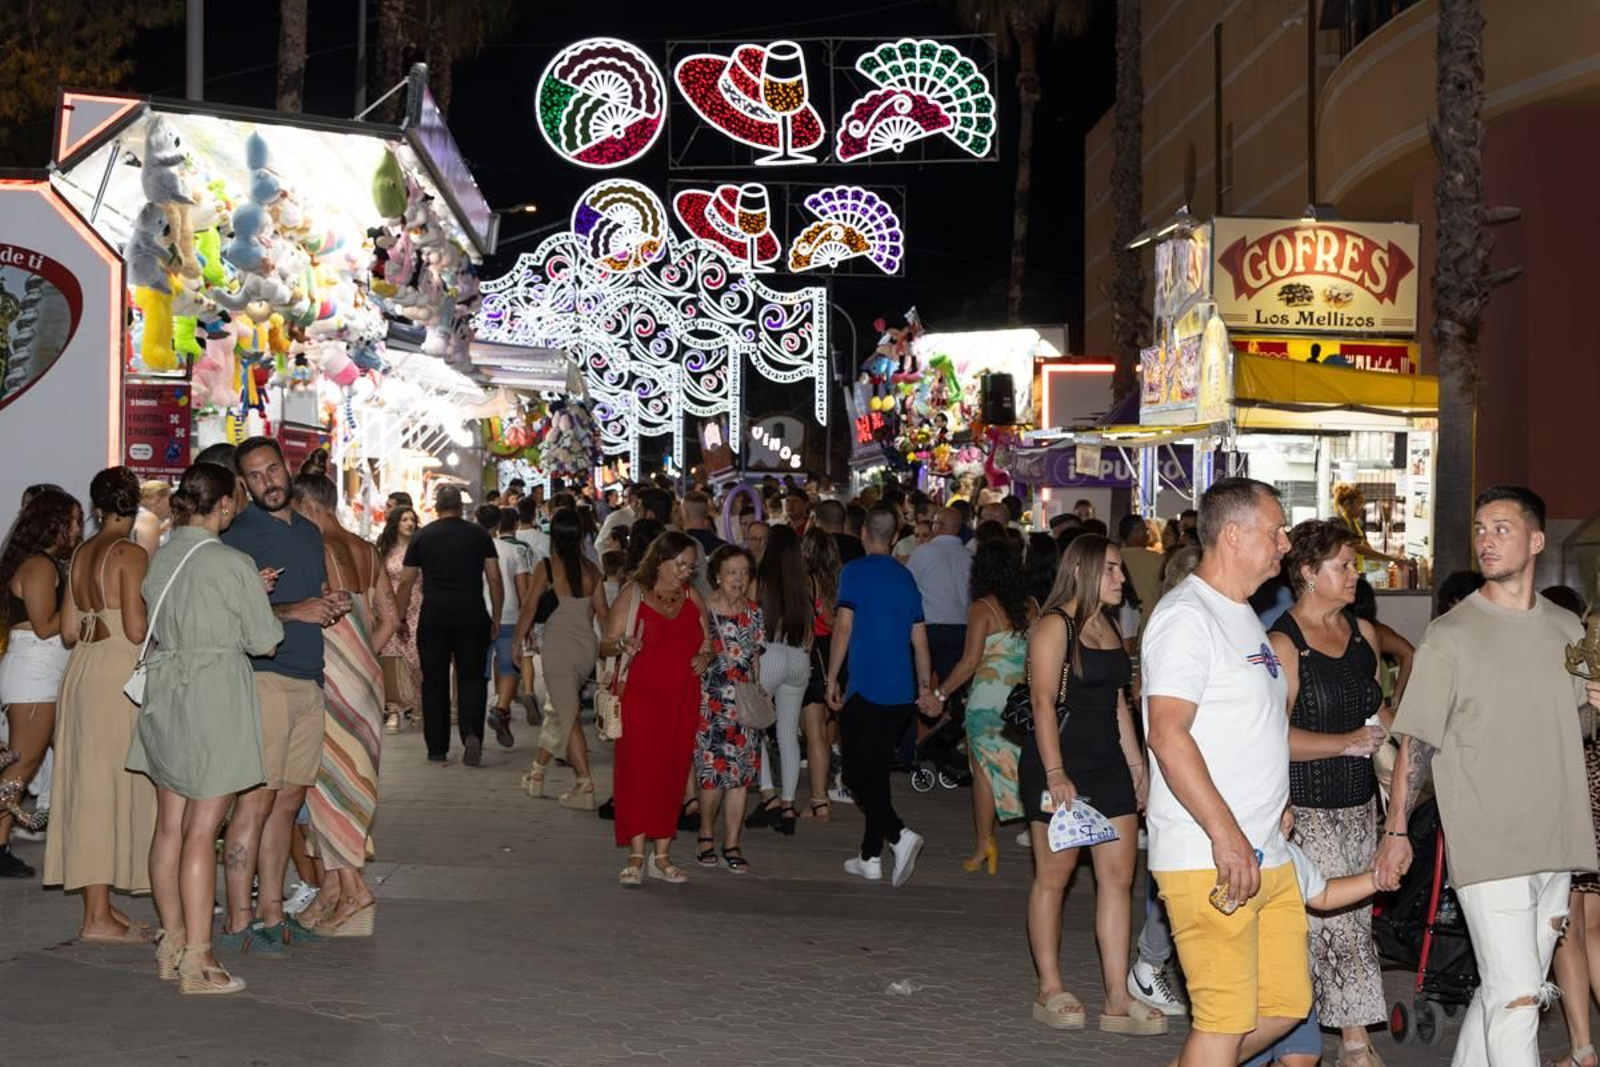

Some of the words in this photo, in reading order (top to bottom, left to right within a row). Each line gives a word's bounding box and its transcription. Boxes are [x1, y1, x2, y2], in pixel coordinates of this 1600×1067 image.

[28, 254, 43, 270] ti
[1243, 229, 1390, 295] GOFRES
[1255, 309, 1289, 325] Los
[1295, 310, 1375, 328] Mellizos
[752, 426, 801, 468] VINOS
